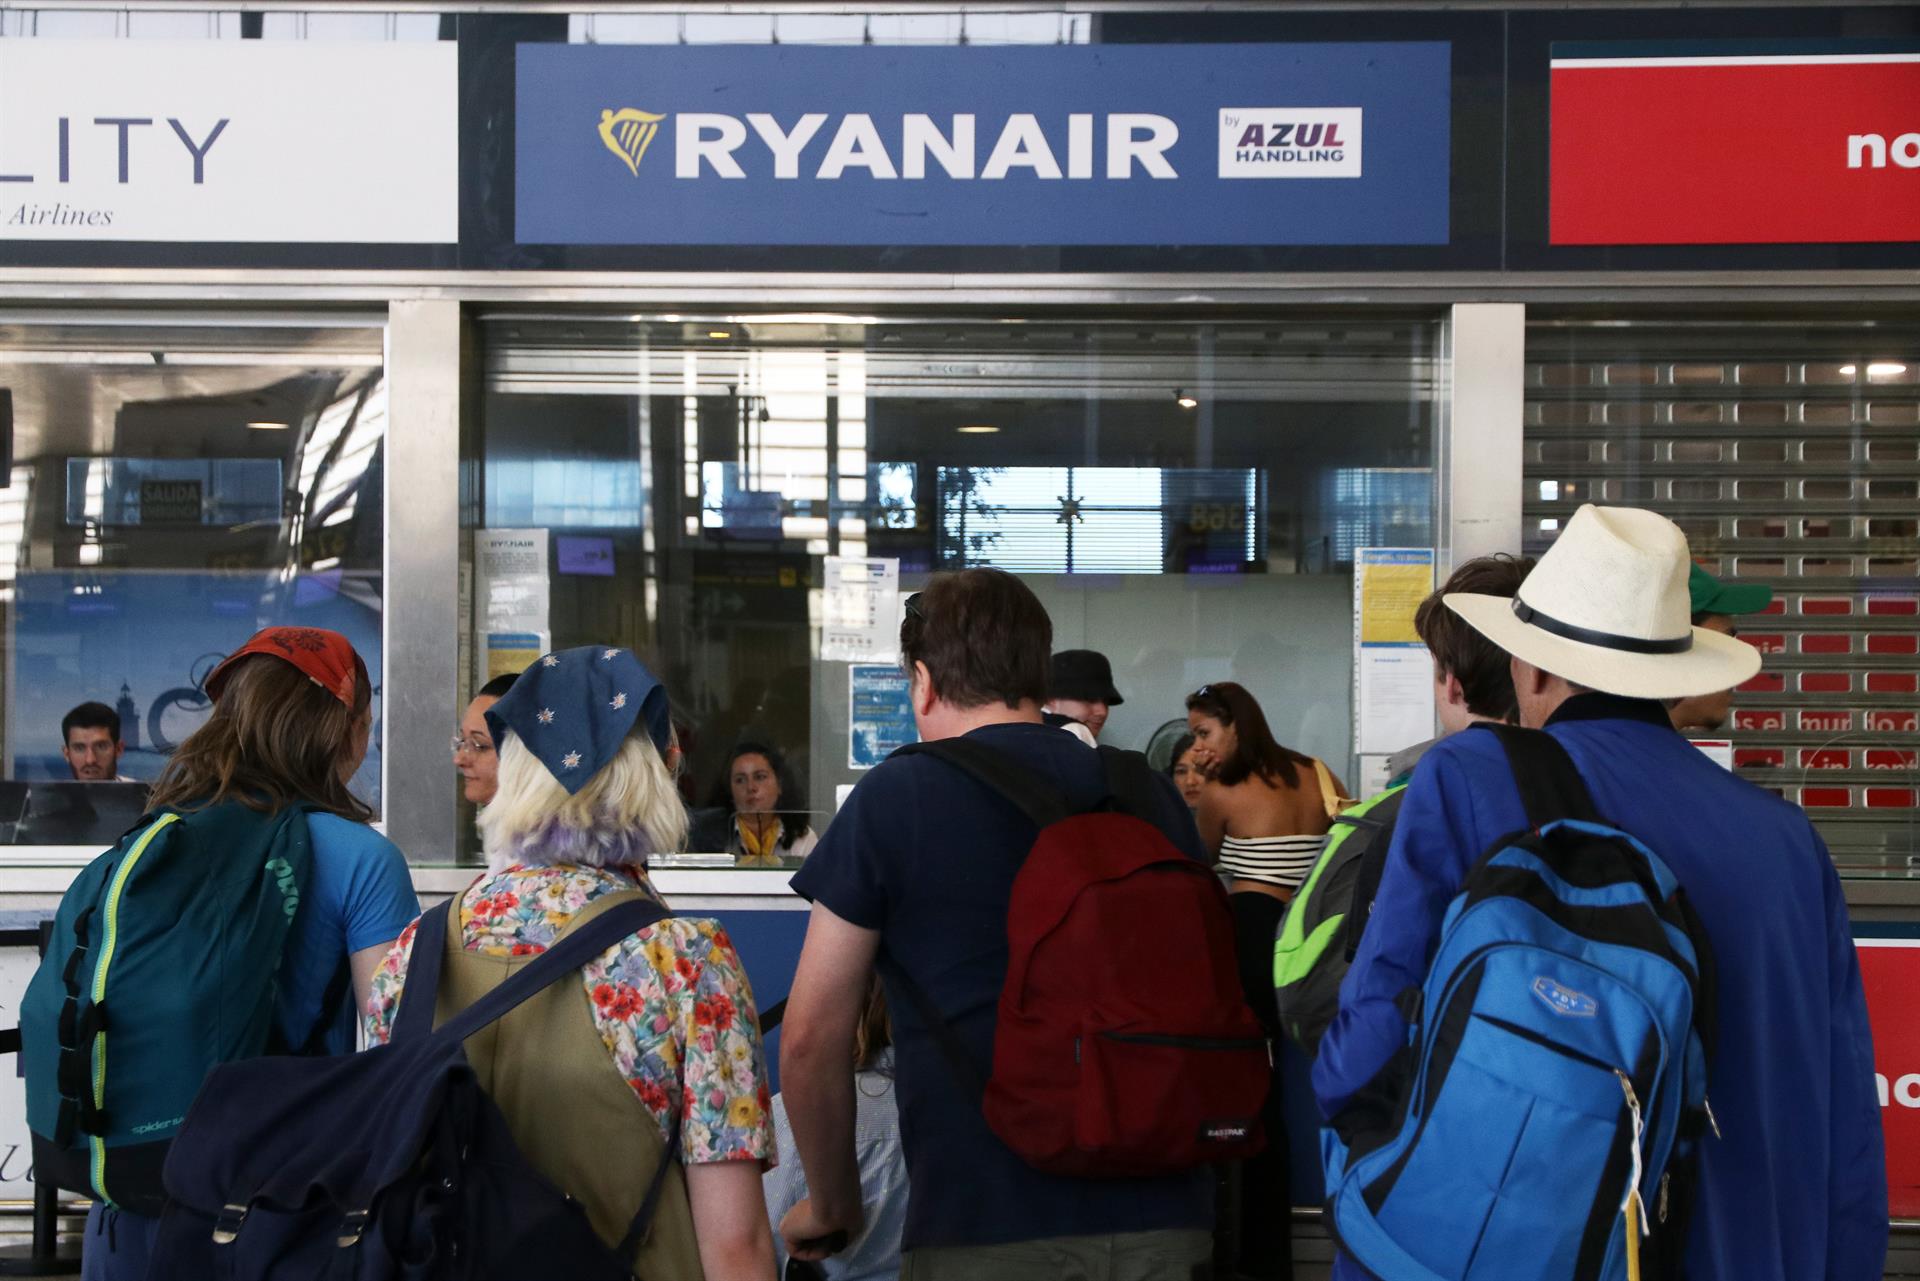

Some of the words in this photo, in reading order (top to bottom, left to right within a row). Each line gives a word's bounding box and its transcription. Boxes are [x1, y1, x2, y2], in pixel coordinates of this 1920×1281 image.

[1224, 115, 1241, 128] by
[675, 112, 1179, 180] RYANAIR
[1237, 123, 1344, 147] AZUL
[1235, 150, 1345, 162] HANDLING
[1847, 132, 1920, 169] no
[8, 203, 114, 226] Airlines
[1207, 1127, 1246, 1137] EASTPAK
